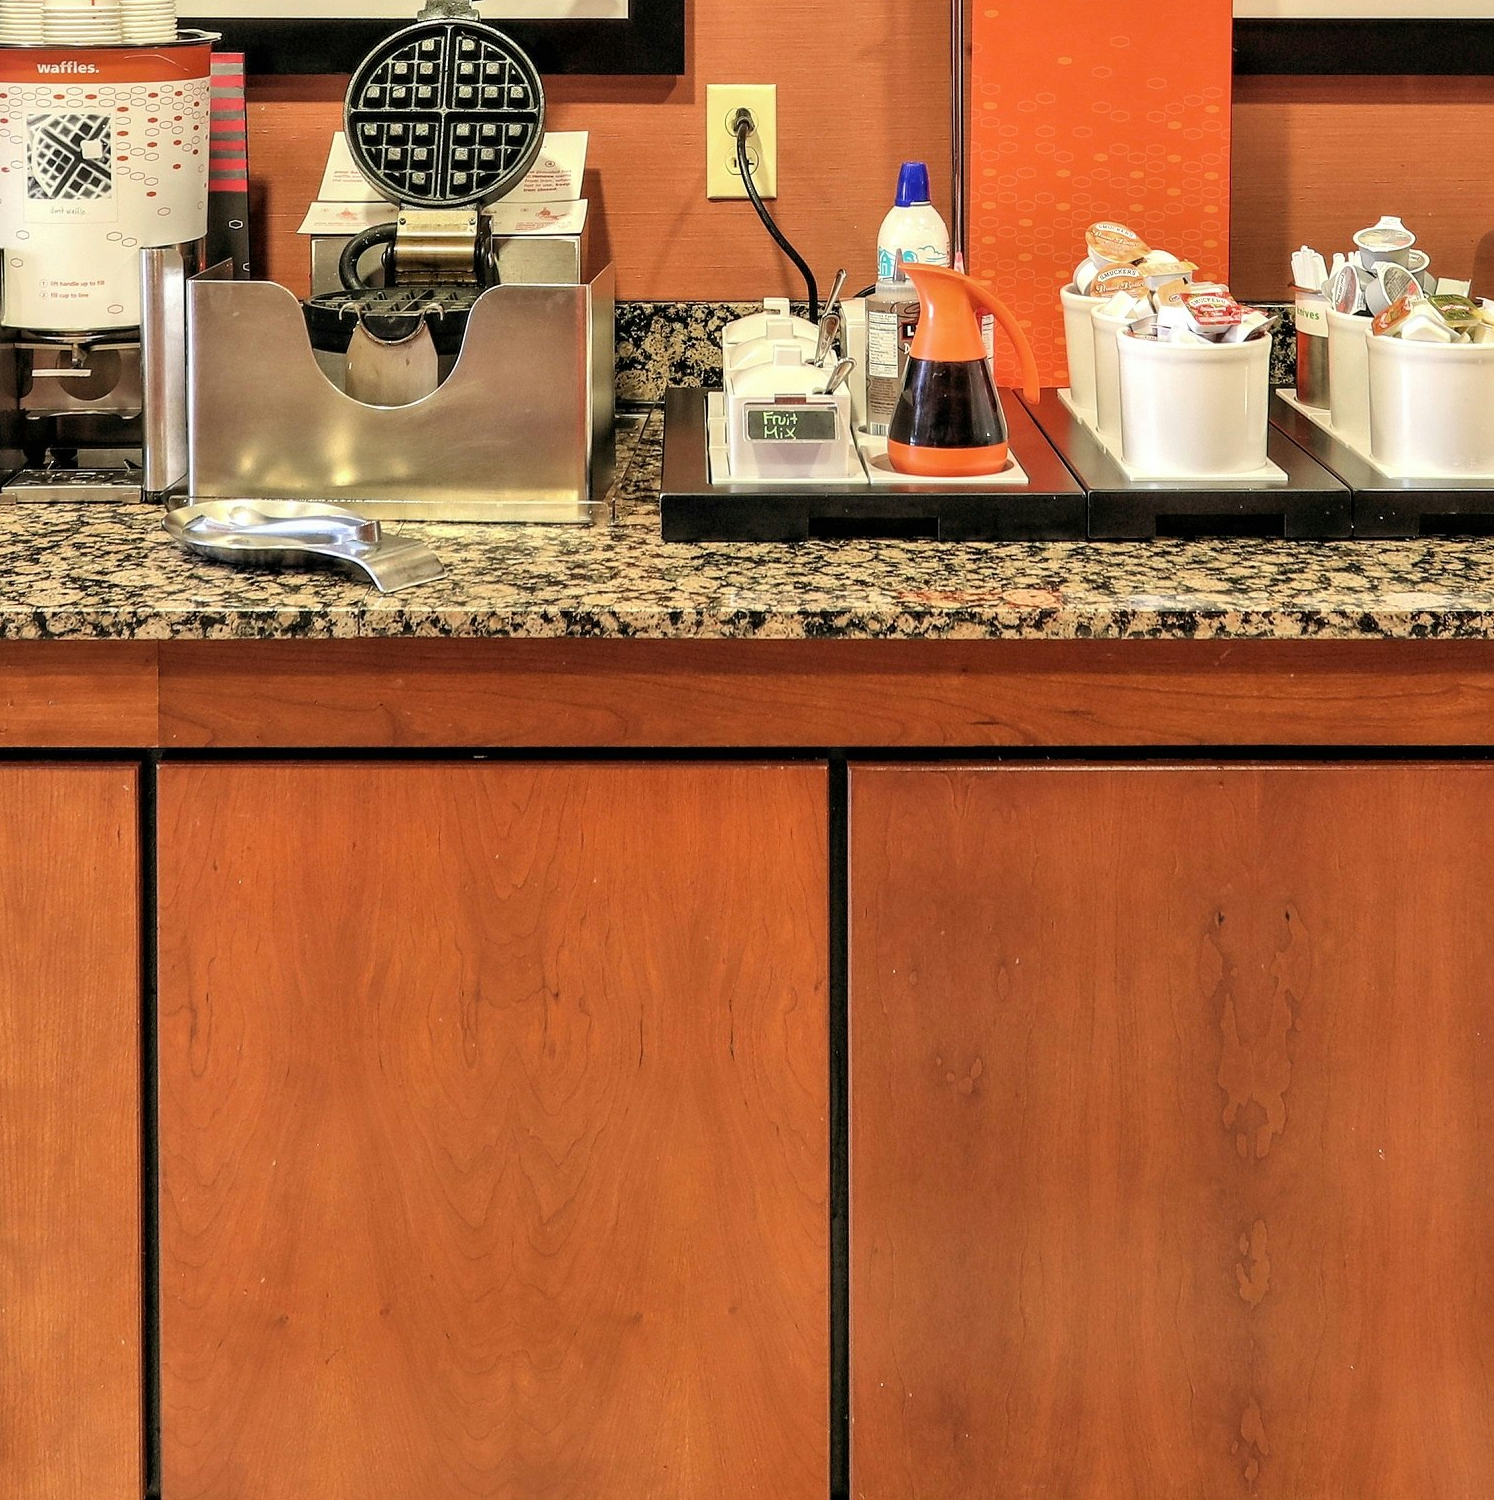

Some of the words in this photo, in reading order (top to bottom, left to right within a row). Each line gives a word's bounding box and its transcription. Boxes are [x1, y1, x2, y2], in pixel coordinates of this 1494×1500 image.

[37, 61, 99, 73] waffles.
[763, 411, 798, 425] Fruit
[764, 426, 796, 440] Mix
